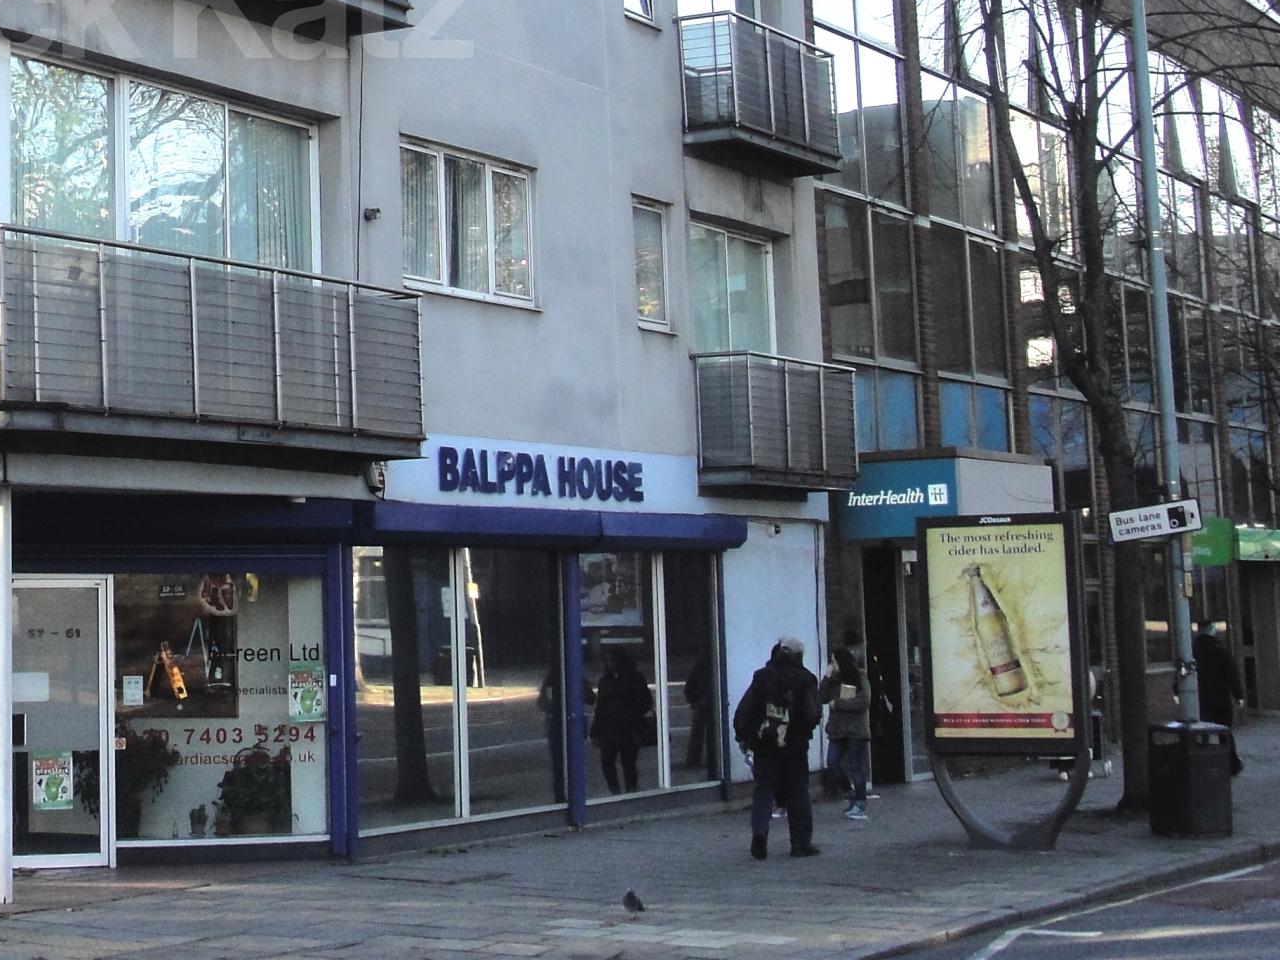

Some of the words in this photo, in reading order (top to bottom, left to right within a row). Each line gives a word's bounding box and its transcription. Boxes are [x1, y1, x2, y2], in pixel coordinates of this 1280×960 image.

[438, 446, 552, 497] BALPPA
[558, 455, 644, 503] HOUSE
[847, 488, 924, 506] InterHealth
[1115, 516, 1135, 526] Bus
[1138, 511, 1161, 523] lane
[939, 533, 961, 543] The
[963, 532, 991, 542] most
[994, 529, 1054, 542] refreshing
[1118, 522, 1163, 536] cameras
[948, 544, 976, 556] cider
[980, 544, 1000, 555] has
[290, 643, 320, 662] Ltd
[235, 685, 289, 697] pecialists
[184, 727, 244, 745] 7403
[254, 725, 317, 744] 5294
